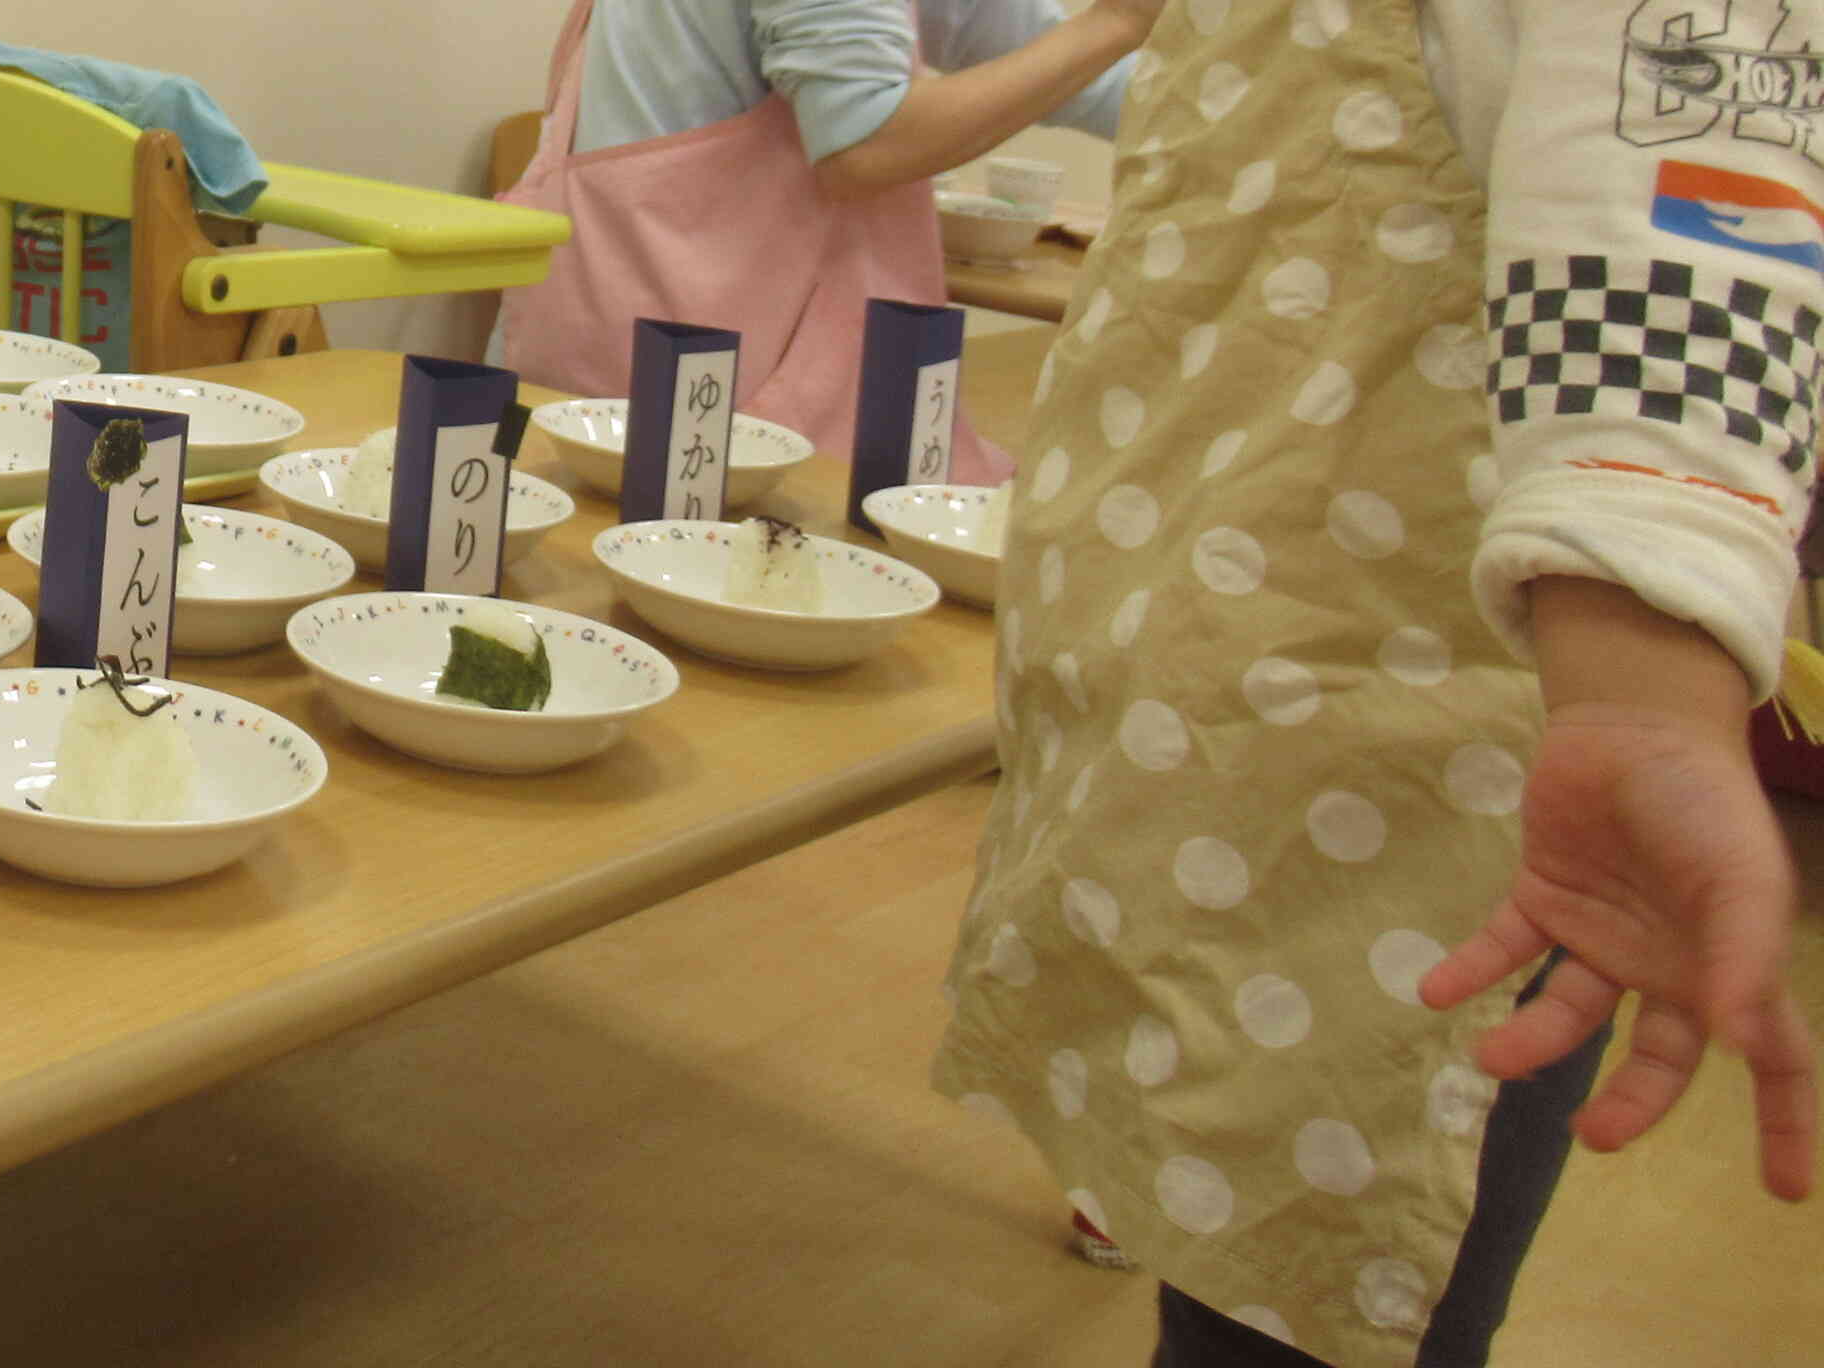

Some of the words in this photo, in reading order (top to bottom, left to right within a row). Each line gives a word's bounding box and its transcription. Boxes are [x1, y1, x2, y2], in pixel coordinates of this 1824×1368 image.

[679, 372, 721, 520] ゆかり
[919, 380, 945, 478] うめ
[120, 476, 160, 675] こんぶ
[450, 457, 490, 577] のり
